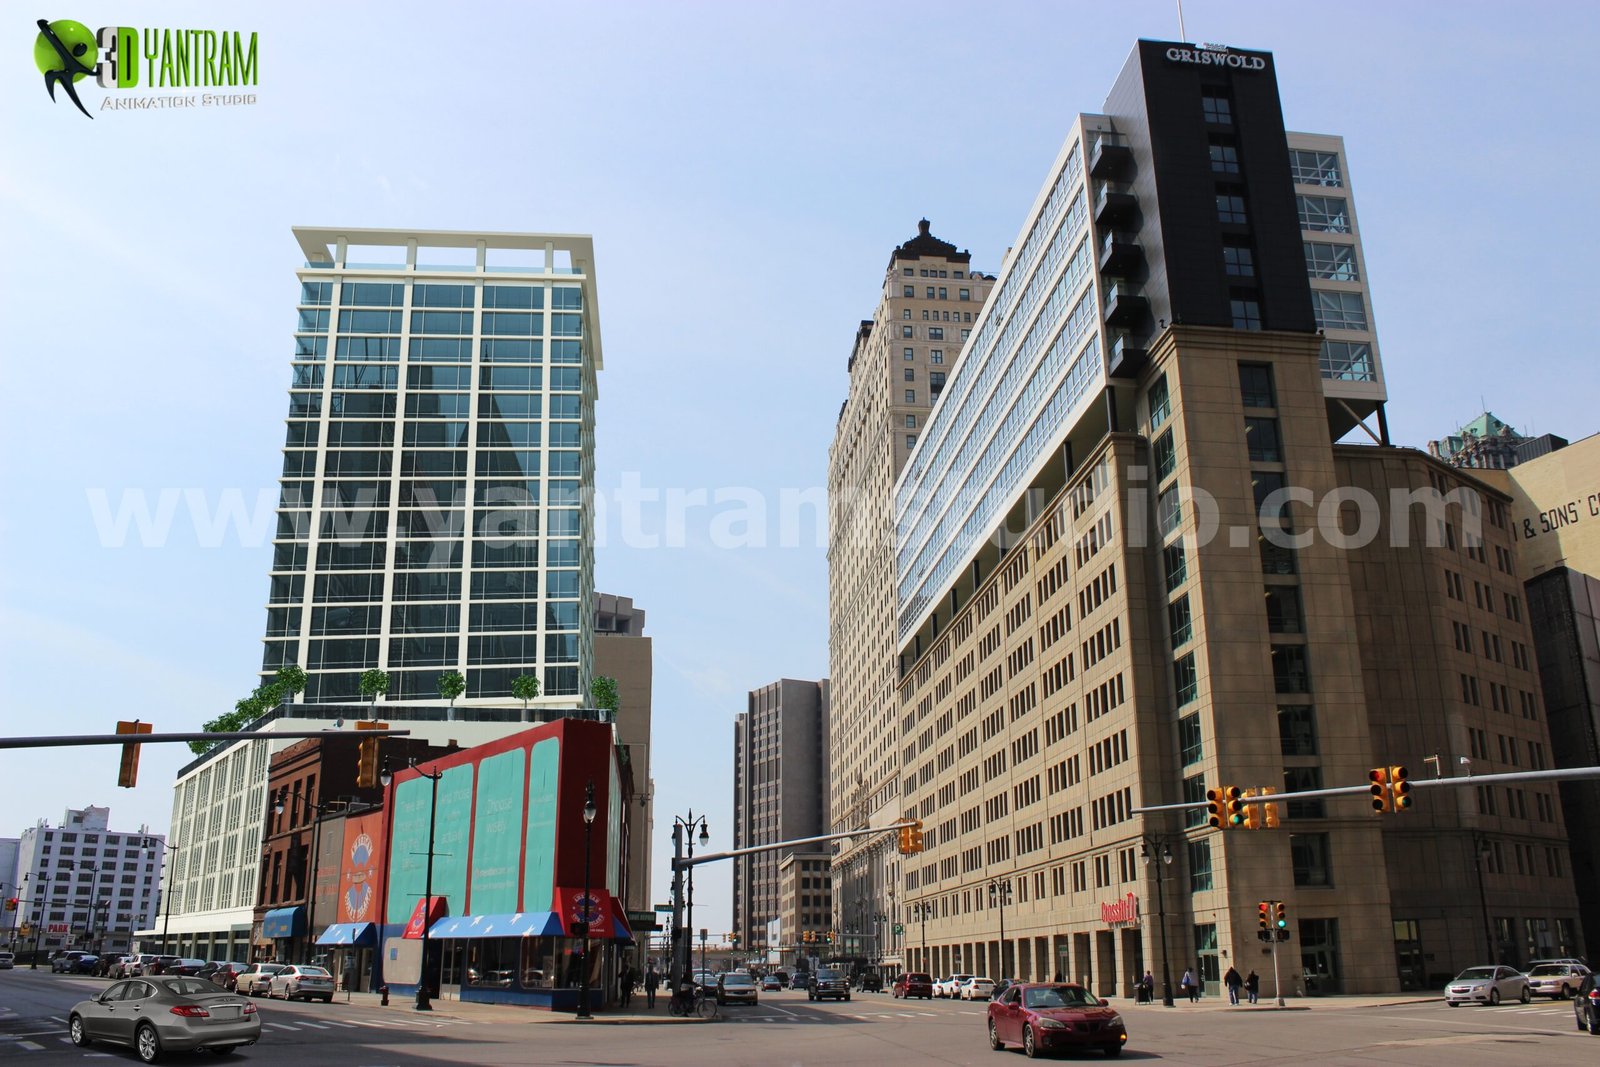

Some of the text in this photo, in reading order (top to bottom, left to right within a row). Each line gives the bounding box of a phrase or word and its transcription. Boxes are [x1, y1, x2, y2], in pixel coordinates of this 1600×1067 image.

[1166, 48, 1265, 70] GRISWOLD
[1523, 518, 1537, 539] &
[48, 924, 69, 932] PARK
